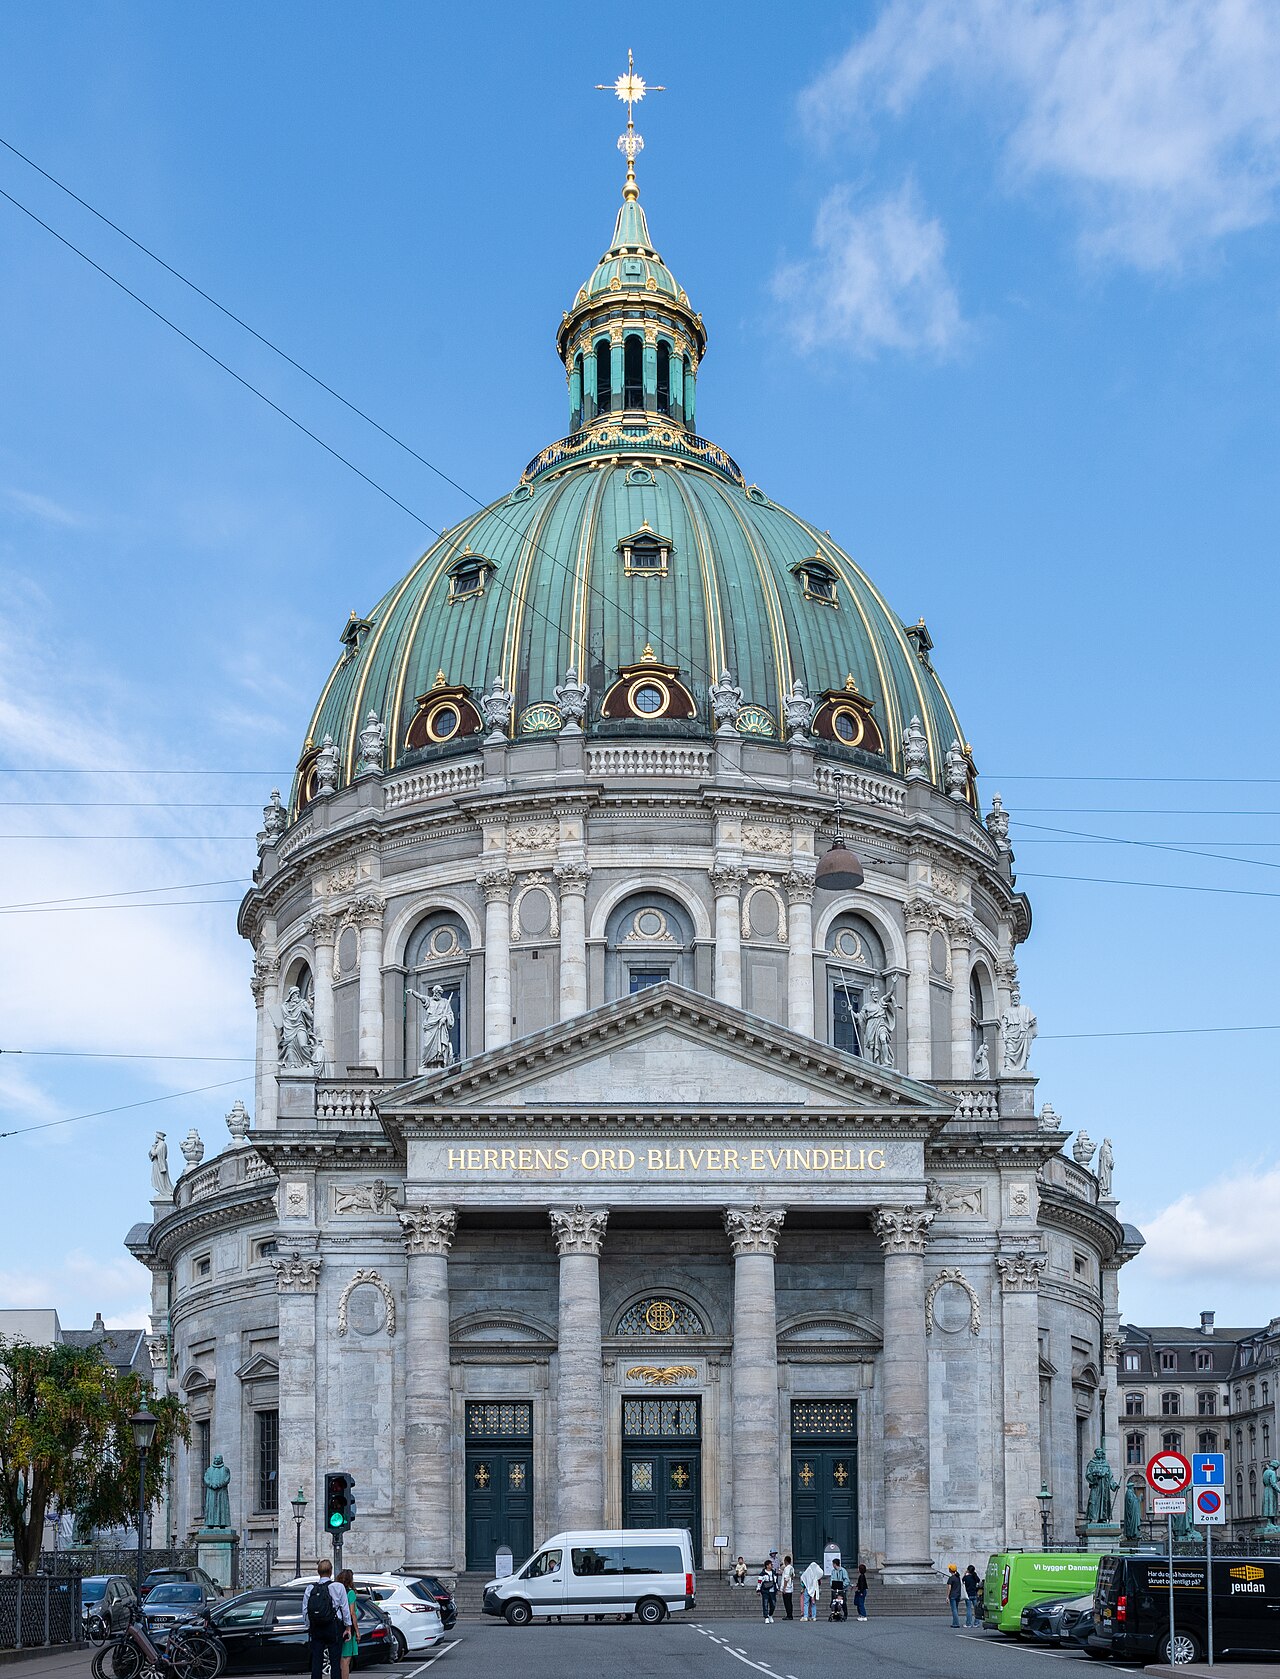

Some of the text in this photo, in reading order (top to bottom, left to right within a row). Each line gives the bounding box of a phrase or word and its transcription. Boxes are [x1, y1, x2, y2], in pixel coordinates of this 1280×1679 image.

[448, 1148, 887, 1170] HERRENS ORD BLIVER EVINDELIG
[1231, 1582, 1265, 1595] jeudan
